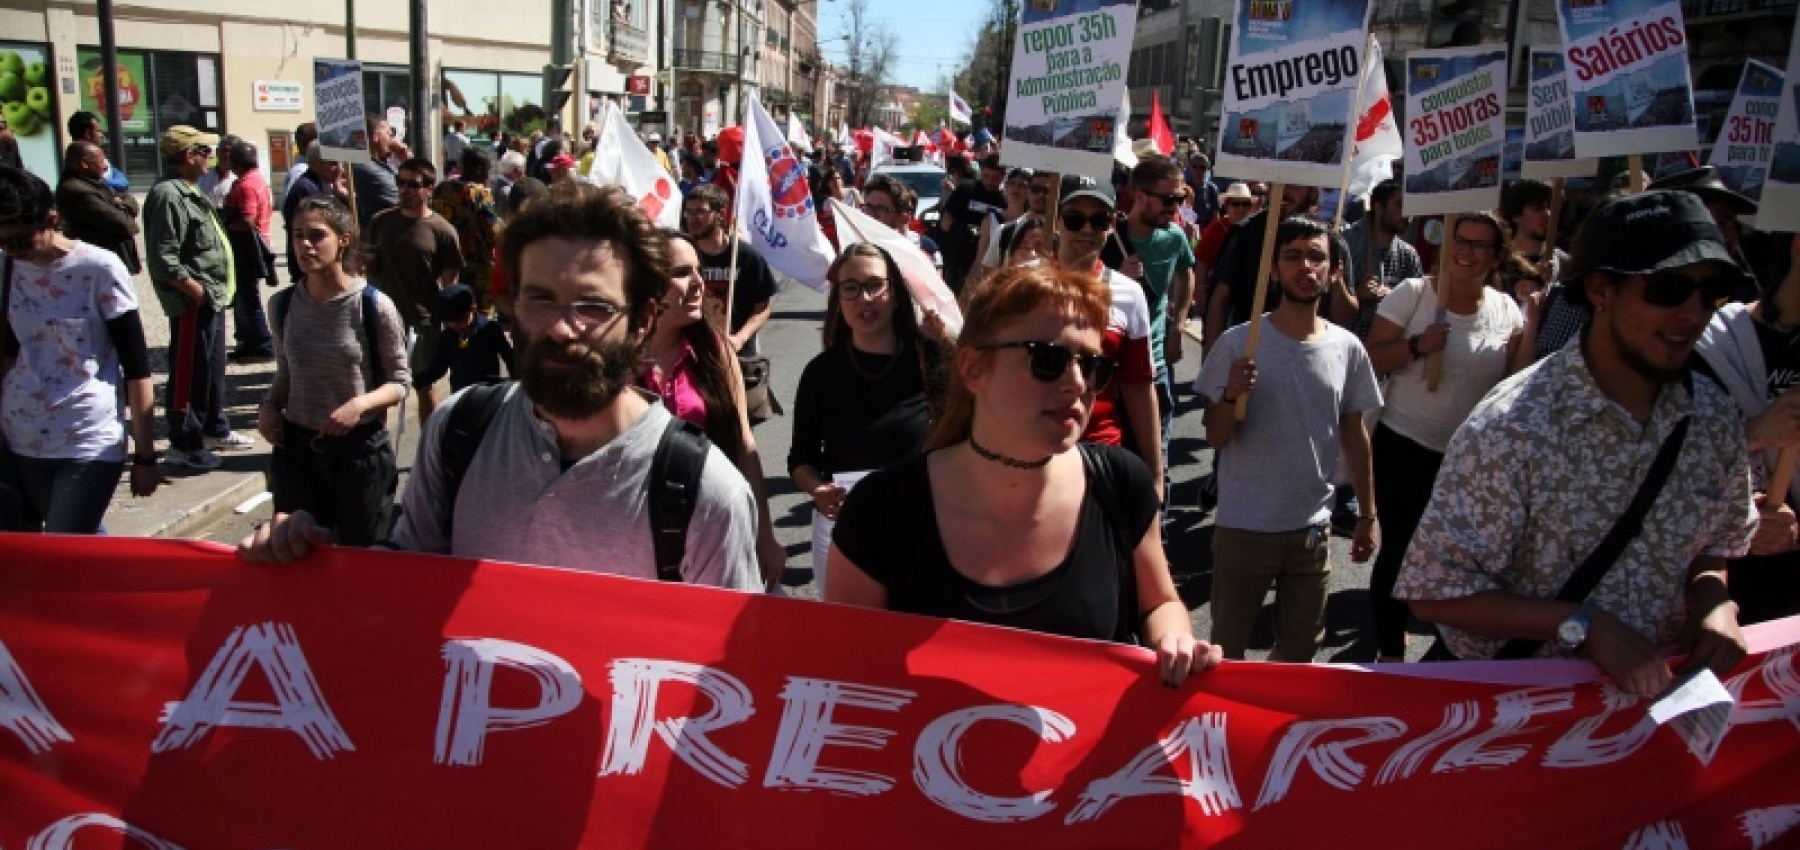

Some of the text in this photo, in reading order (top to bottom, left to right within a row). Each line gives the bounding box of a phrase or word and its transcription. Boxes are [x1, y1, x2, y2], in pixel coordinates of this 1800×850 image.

[1023, 12, 1117, 54] repor 35h
[1568, 16, 1684, 81] Salários
[1016, 60, 1122, 98] Administração
[1046, 46, 1092, 74] para a
[1231, 45, 1358, 100] Emprego
[1042, 89, 1097, 115] Pública
[1420, 71, 1494, 112] conquistar
[1410, 93, 1501, 146] 35 horas
[1728, 116, 1751, 143] 35
[1420, 124, 1493, 166] para todos
